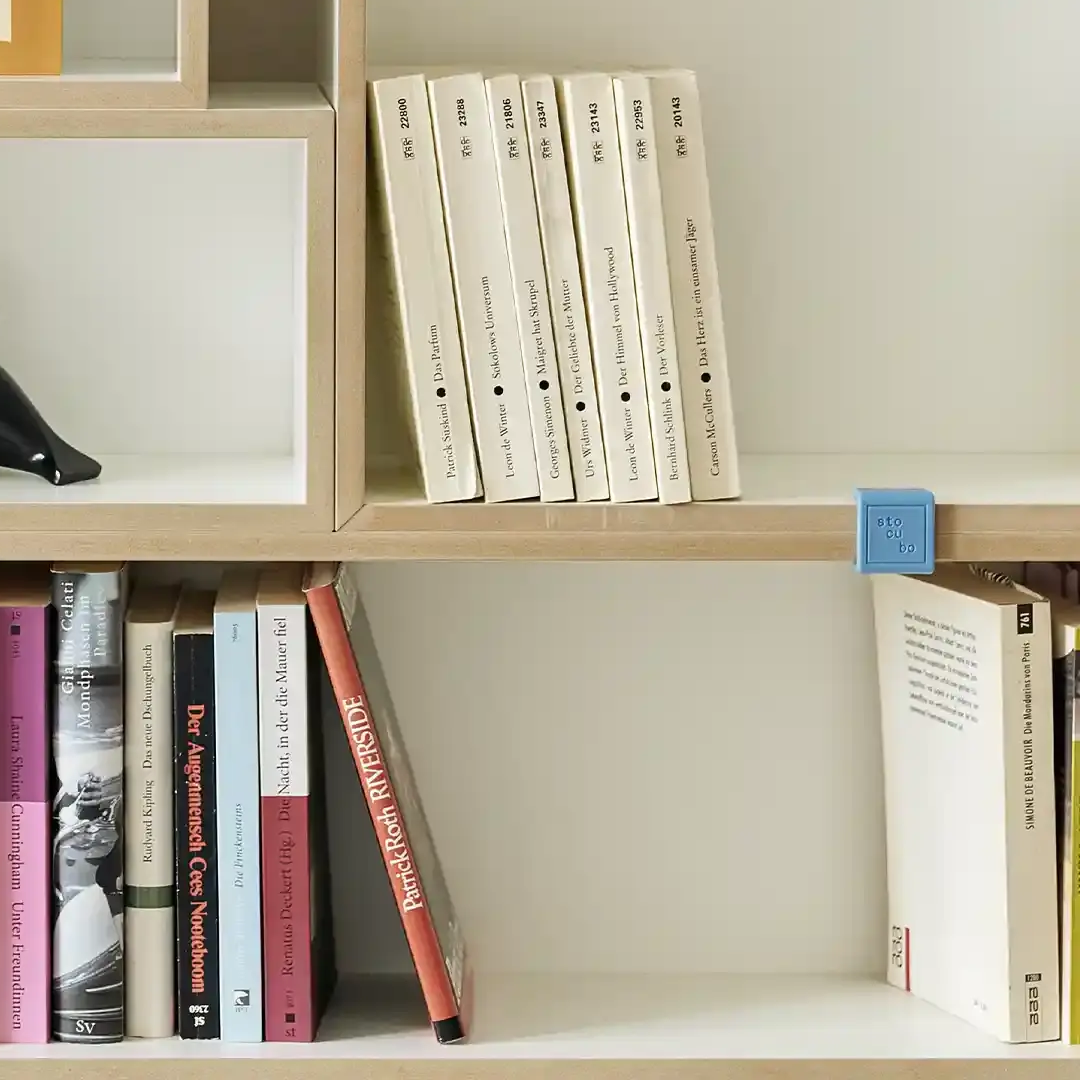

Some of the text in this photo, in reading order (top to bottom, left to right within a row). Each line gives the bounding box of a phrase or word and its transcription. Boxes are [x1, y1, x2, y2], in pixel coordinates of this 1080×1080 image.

[397, 98, 410, 129] 22800
[456, 98, 467, 126] 23288
[503, 98, 514, 129] 21806
[537, 101, 548, 128] 23347
[589, 102, 600, 133] 23143
[634, 100, 644, 130] 22953
[672, 97, 683, 128] 20143
[428, 325, 441, 360] Parfum
[683, 218, 720, 476] Carson McCullers Das Herz ist ein einsamer Jäger
[433, 363, 444, 382] Das
[480, 276, 515, 478] Leon de Winter Sokolows Universum
[524, 279, 561, 479] Georges Simenon Maigret hat Skrupel
[560, 279, 596, 478] Urs Widmer Der Geliebte der Mutter
[604, 247, 639, 481] Leon de Winter Der Himmel von Hollywood
[654, 314, 679, 481] Bernhard Schlink Der Vorleser
[444, 445, 456, 478] Patrick
[877, 517, 902, 527] sto
[887, 529, 902, 539] cu
[900, 540, 916, 553] bo
[273, 618, 286, 637] fiel
[1021, 613, 1030, 628] 761
[61, 582, 73, 694] Gianni Celati
[77, 623, 94, 728] Mondphasen
[275, 641, 287, 683] Mauer
[142, 644, 155, 720] Dschungelbuch
[275, 687, 288, 706] die
[276, 712, 289, 732] der
[1022, 642, 1035, 830] SIMONE DE BEAUVOIR Die Mandarins von Paris
[277, 736, 289, 748] in
[142, 750, 152, 769] Das
[276, 753, 290, 795] Nacht,
[142, 780, 155, 817] Kipling
[277, 800, 290, 821] Die
[342, 695, 423, 912] Patrick Roth RIVERSIDE
[142, 821, 155, 863] Rudyard
[183, 704, 208, 993] Der Augenmensch Cees Nooteboom
[277, 831, 295, 865] (Hg.)
[8, 716, 25, 1029] Laura Shaine Cunningham Unter Freundinnen
[233, 871, 244, 889] Die
[279, 869, 293, 920] Deckert
[280, 925, 293, 976] Renatus
[189, 1005, 209, 1013] 2360
